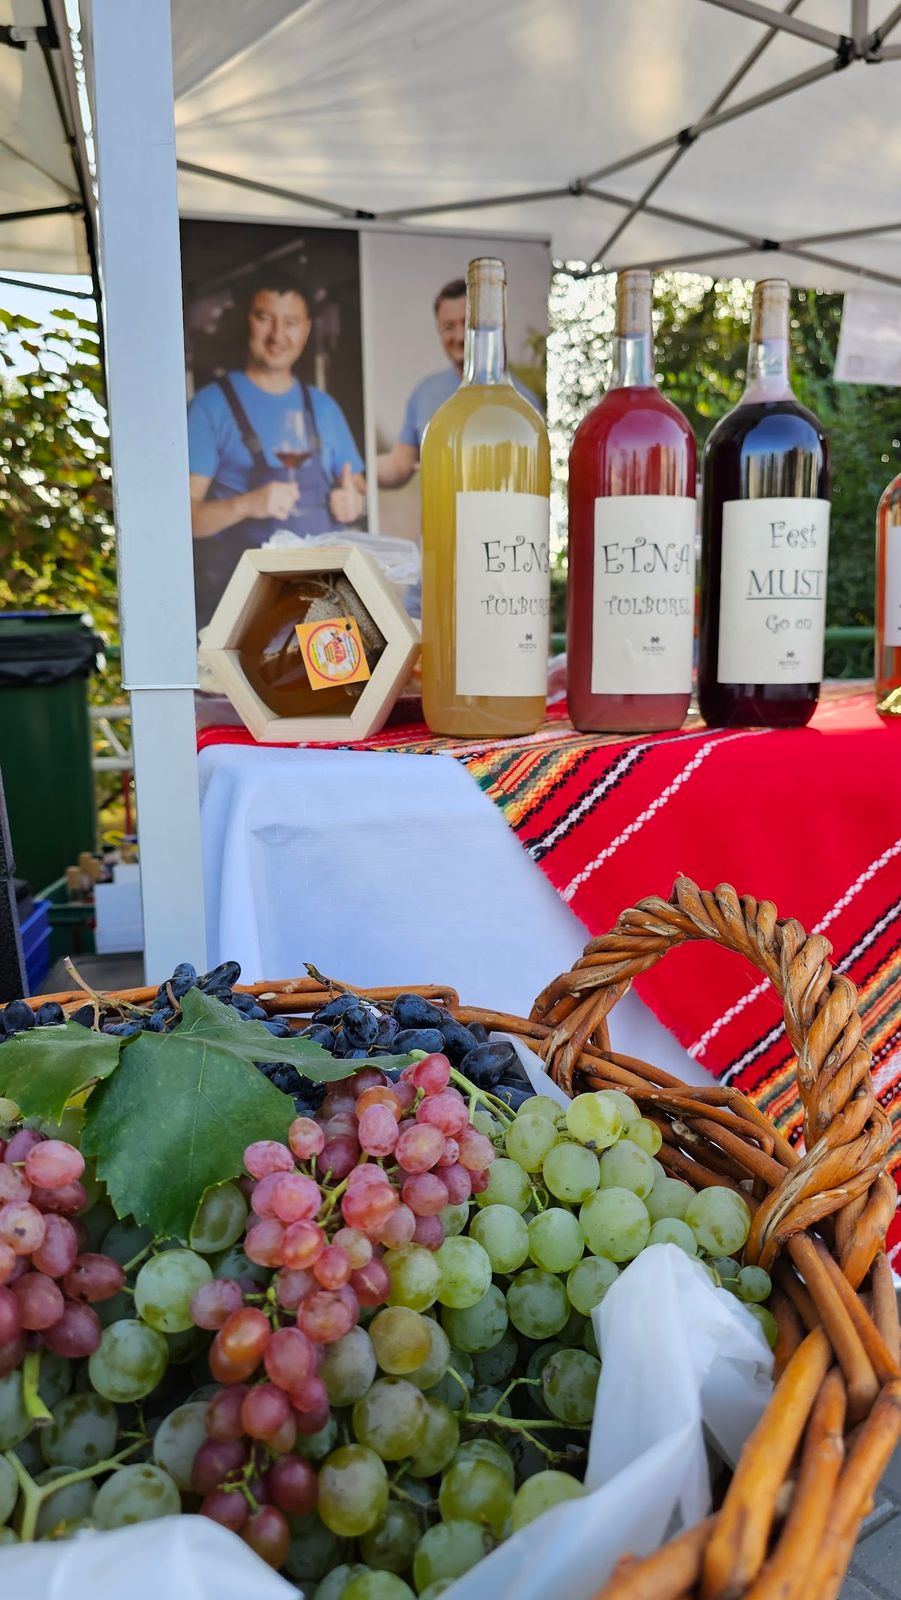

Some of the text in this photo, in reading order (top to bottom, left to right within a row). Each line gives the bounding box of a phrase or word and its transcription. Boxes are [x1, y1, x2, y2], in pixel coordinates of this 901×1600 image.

[768, 521, 817, 549] Fest
[600, 536, 690, 574] ETNA
[747, 569, 823, 596] MUST
[766, 614, 812, 634] Go on
